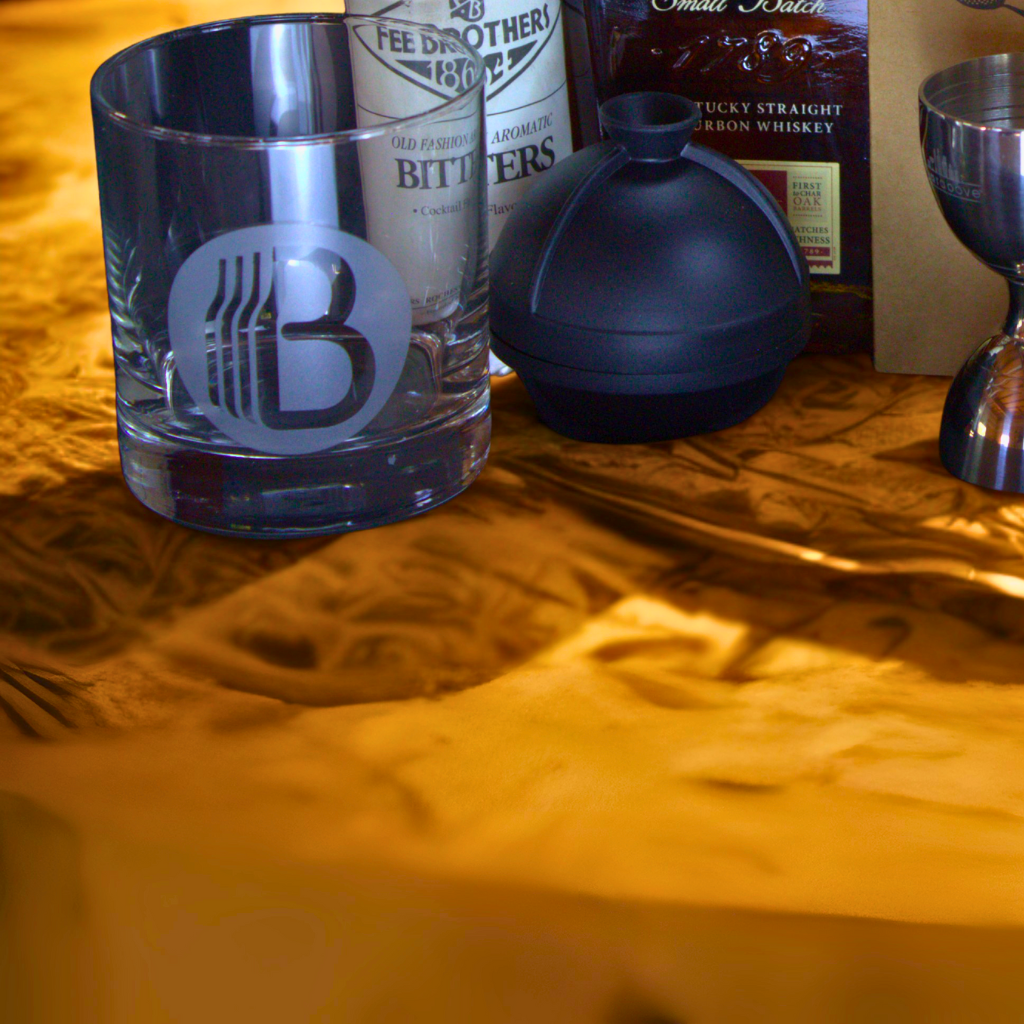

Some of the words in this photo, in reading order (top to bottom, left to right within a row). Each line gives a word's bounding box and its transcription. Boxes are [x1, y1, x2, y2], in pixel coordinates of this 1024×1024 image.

[376, 27, 416, 55] FEE
[756, 102, 844, 117] STRAIGHT
[391, 135, 417, 151] OLD
[490, 111, 554, 145] AROMATIC
[756, 121, 835, 135] WHISKEY
[792, 181, 822, 190] FIRST
[420, 200, 462, 216] Cocktail
[792, 196, 822, 206] OAK
